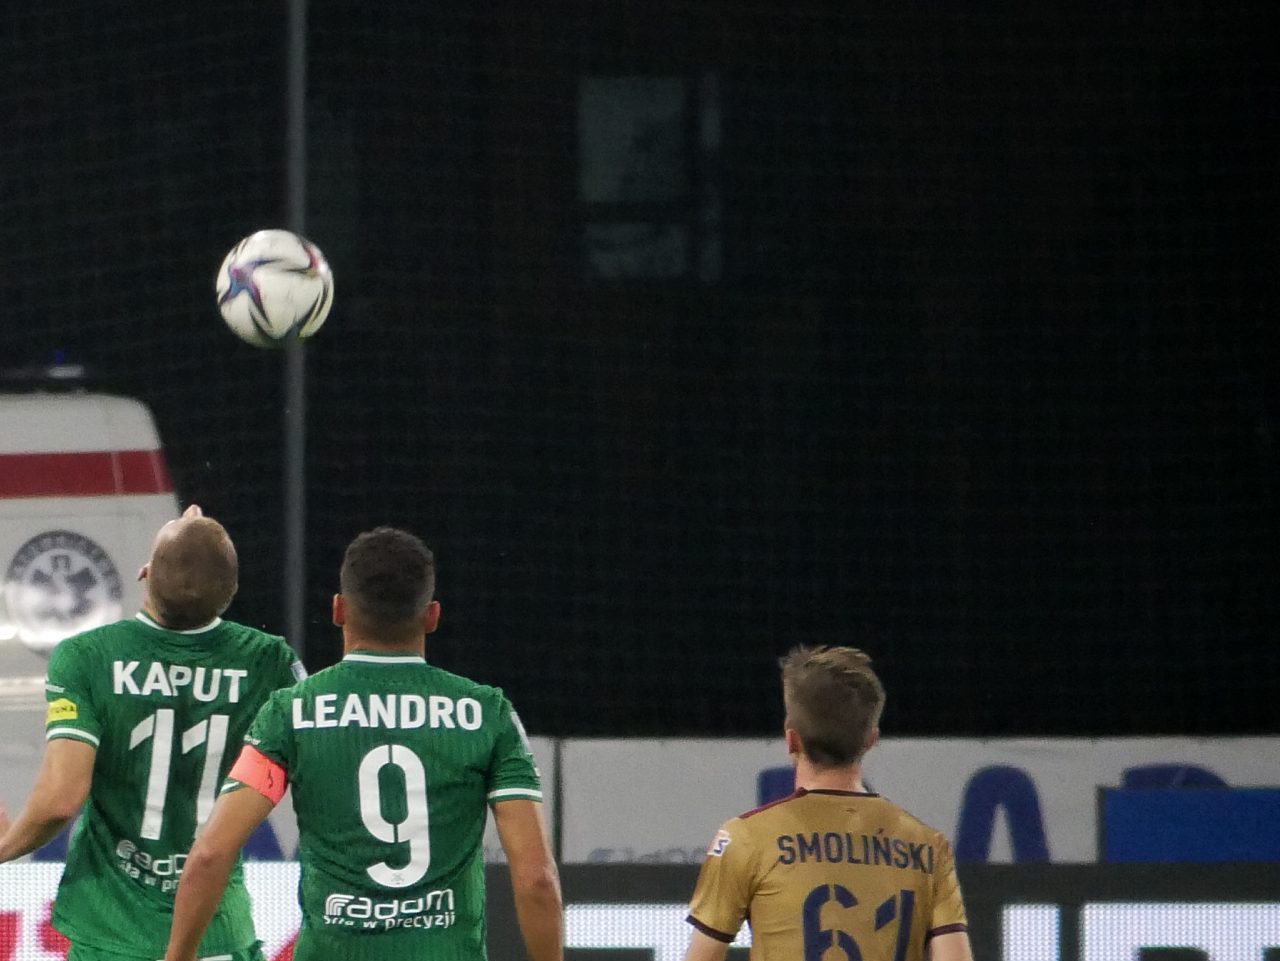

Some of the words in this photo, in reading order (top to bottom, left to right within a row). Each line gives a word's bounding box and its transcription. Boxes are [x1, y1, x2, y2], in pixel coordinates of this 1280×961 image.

[113, 661, 248, 703] KAPUT
[292, 693, 483, 731] LEANDRO
[128, 708, 229, 841] 11
[358, 744, 431, 888] 9
[776, 828, 934, 874] SMOLIŃSKI
[383, 911, 456, 931] precyzji
